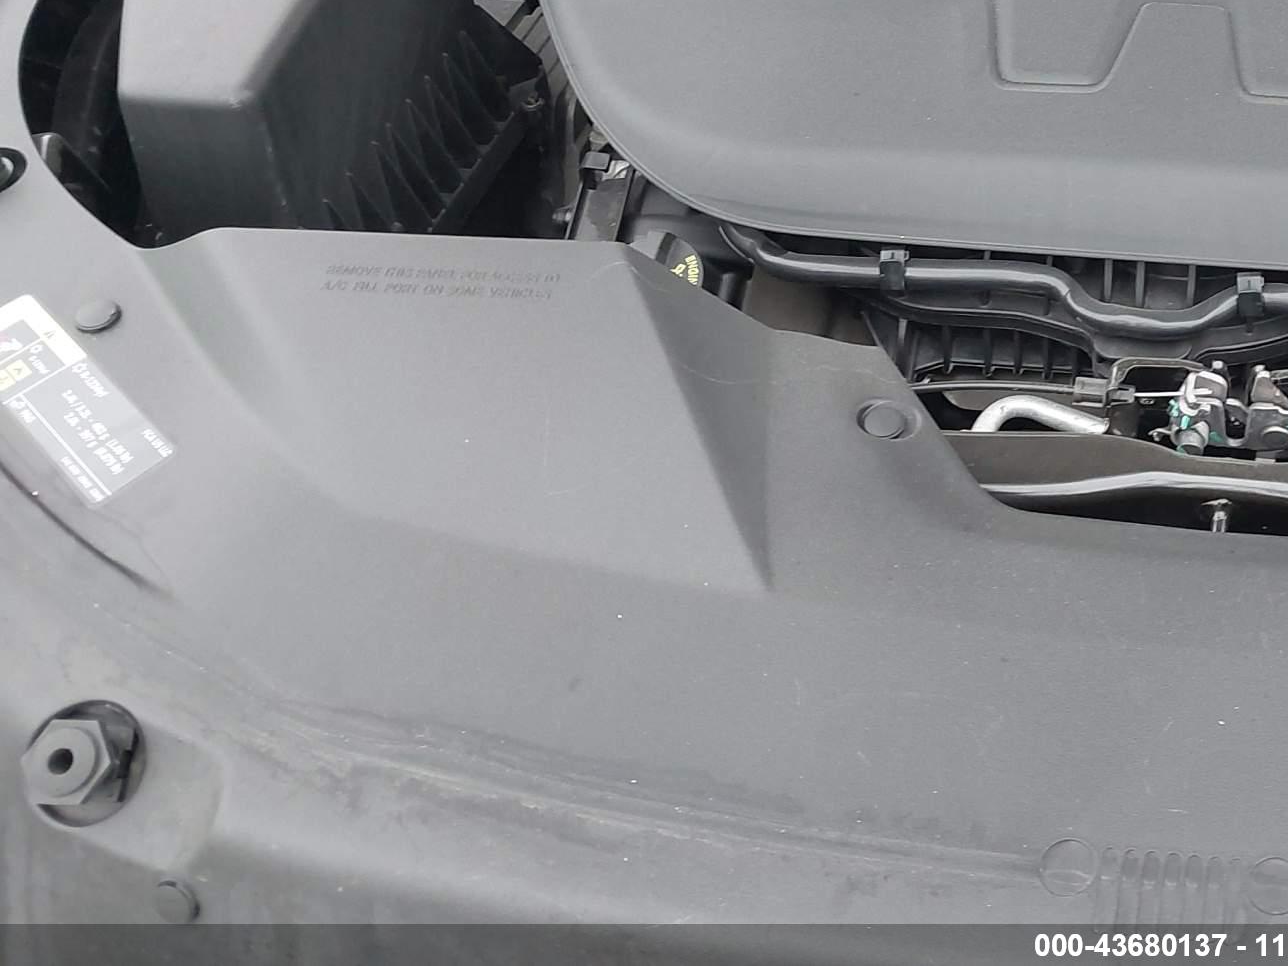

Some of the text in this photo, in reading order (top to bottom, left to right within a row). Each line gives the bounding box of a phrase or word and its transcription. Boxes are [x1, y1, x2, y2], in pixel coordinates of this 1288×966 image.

[325, 264, 382, 276] REMOVE
[383, 266, 415, 278] THIS
[684, 255, 699, 285] ENGIN
[322, 280, 347, 291] A/C
[422, 284, 445, 295] ON
